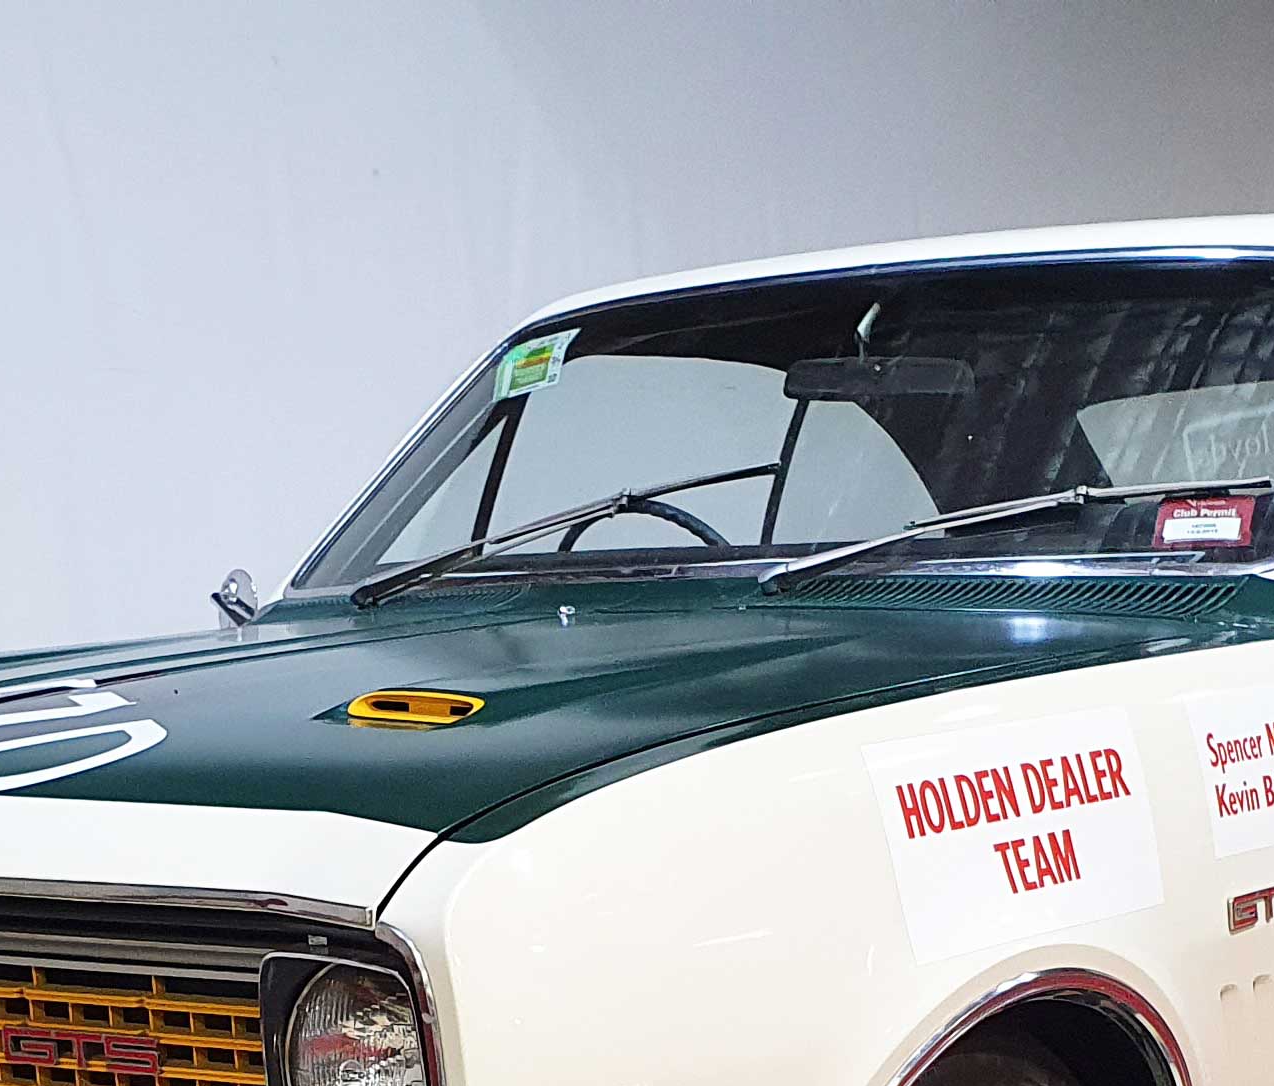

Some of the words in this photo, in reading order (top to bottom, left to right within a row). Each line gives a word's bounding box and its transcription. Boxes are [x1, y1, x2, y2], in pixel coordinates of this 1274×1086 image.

[1173, 507, 1198, 518] Club
[1200, 506, 1237, 517] Permit
[1206, 733, 1263, 774] Spencer
[895, 766, 1021, 839] HOLDEN
[1020, 748, 1131, 814] DEALER
[1215, 780, 1260, 817] Kevin
[993, 829, 1081, 894] TEAM
[3, 1025, 160, 1075] GTS
